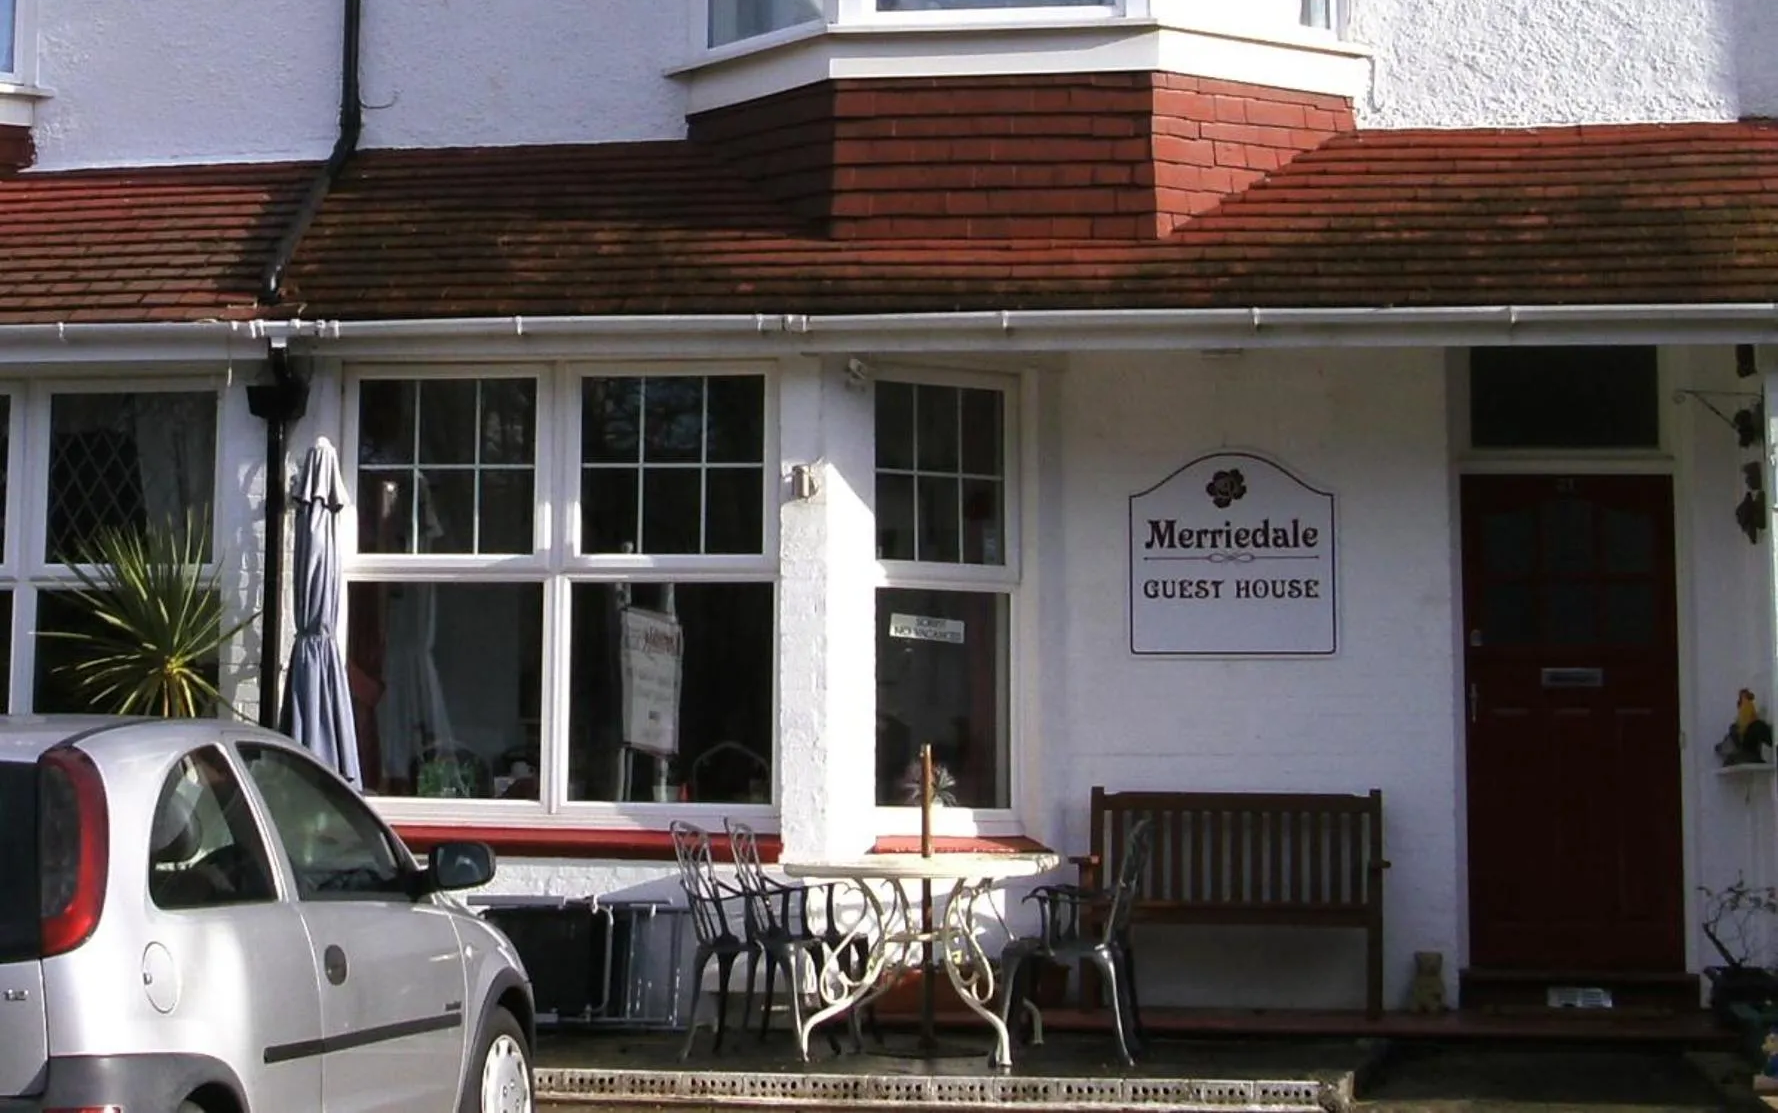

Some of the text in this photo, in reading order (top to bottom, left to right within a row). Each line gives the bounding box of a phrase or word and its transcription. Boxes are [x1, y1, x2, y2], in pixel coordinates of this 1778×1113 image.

[1145, 519, 1318, 549] Merriedale
[1144, 579, 1319, 599] GUEST HOUSE
